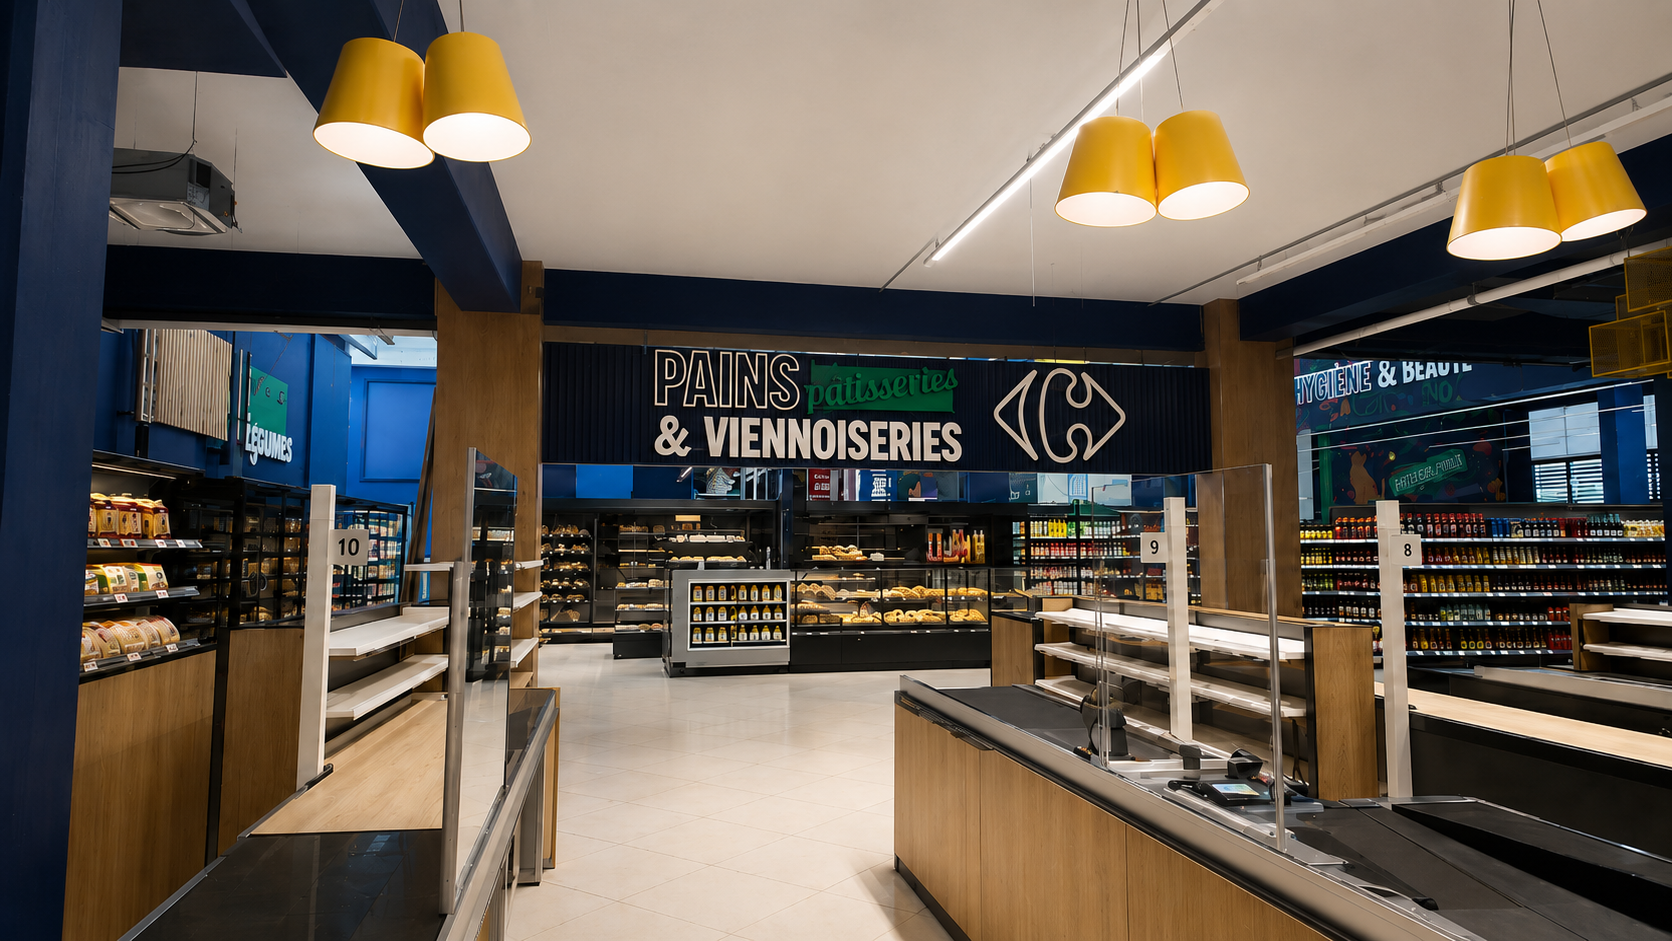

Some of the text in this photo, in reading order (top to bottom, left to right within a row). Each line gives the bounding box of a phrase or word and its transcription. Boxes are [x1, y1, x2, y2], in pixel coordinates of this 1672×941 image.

[654, 349, 801, 411] PAINS
[1377, 361, 1398, 388] &
[654, 415, 963, 462] & VIENNOISERIES
[338, 537, 360, 556] 10
[1150, 539, 1159, 555] 9
[1403, 543, 1413, 557] 8
